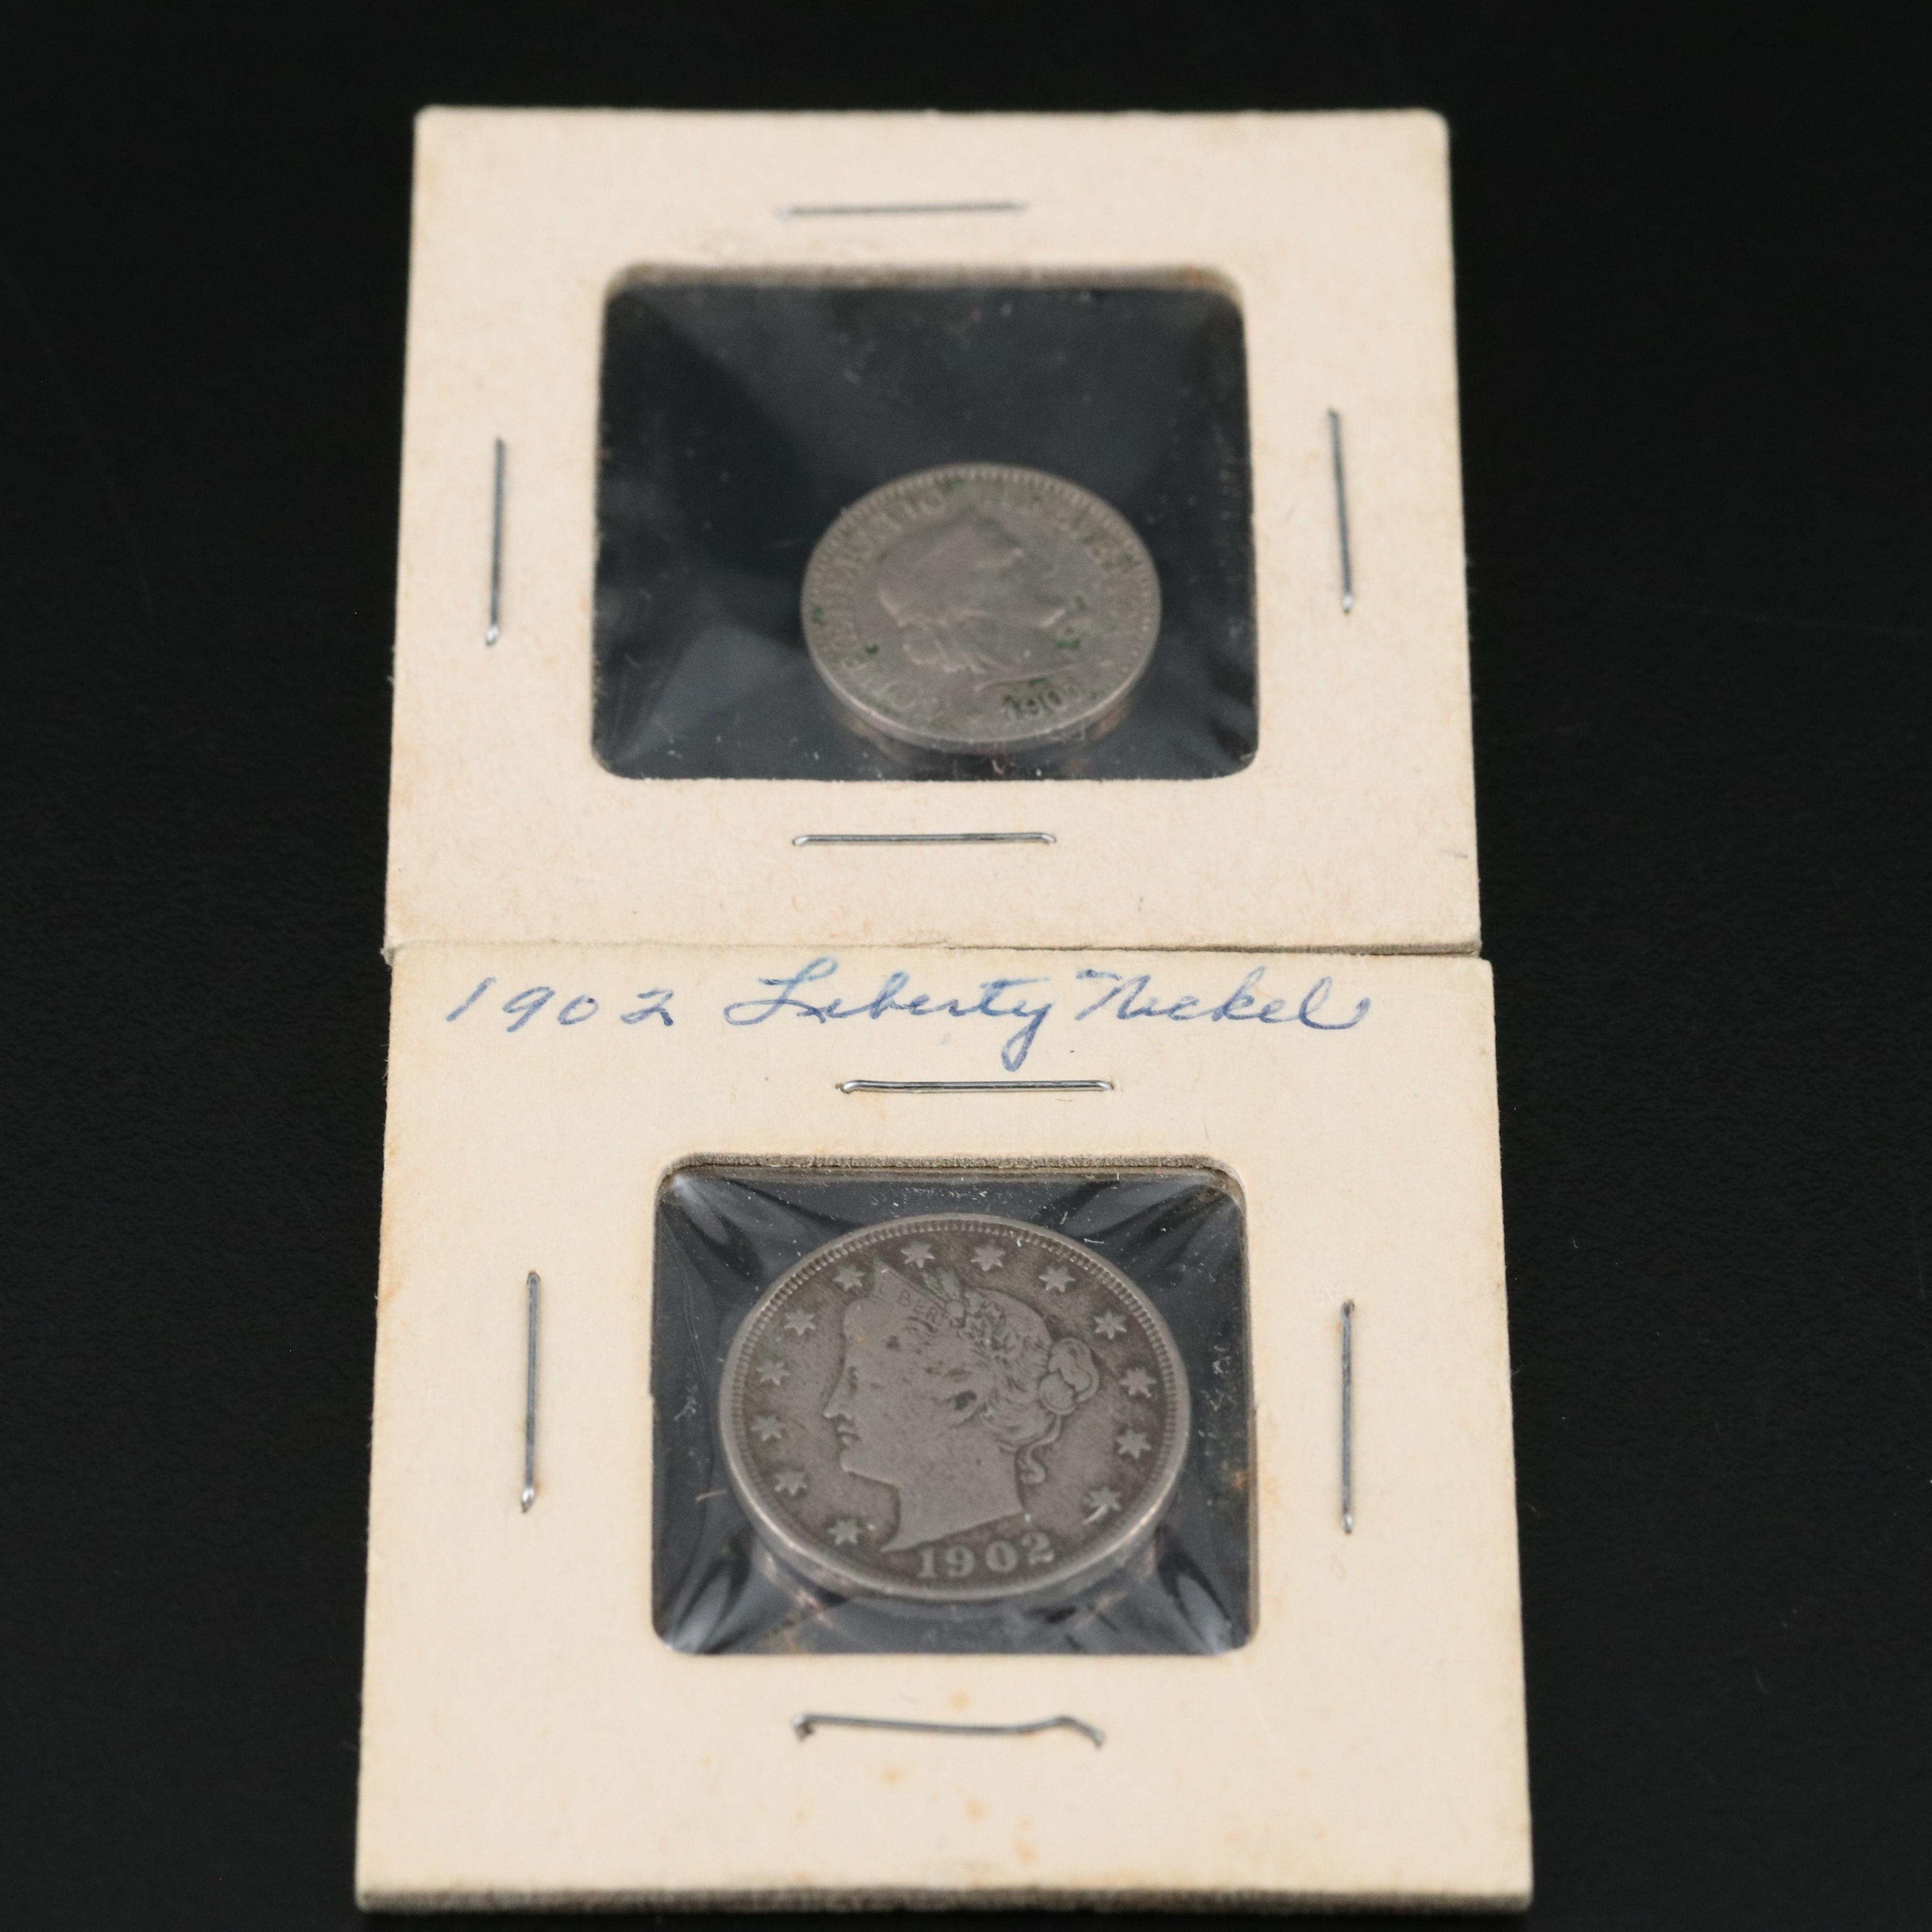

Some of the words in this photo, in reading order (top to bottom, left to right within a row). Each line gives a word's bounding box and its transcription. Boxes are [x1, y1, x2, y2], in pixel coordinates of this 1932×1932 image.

[445, 977, 675, 1033] 1902
[724, 956, 1054, 1072] Liberty
[1074, 966, 1371, 1030] Nickel
[918, 1531, 1056, 1578] 1902
